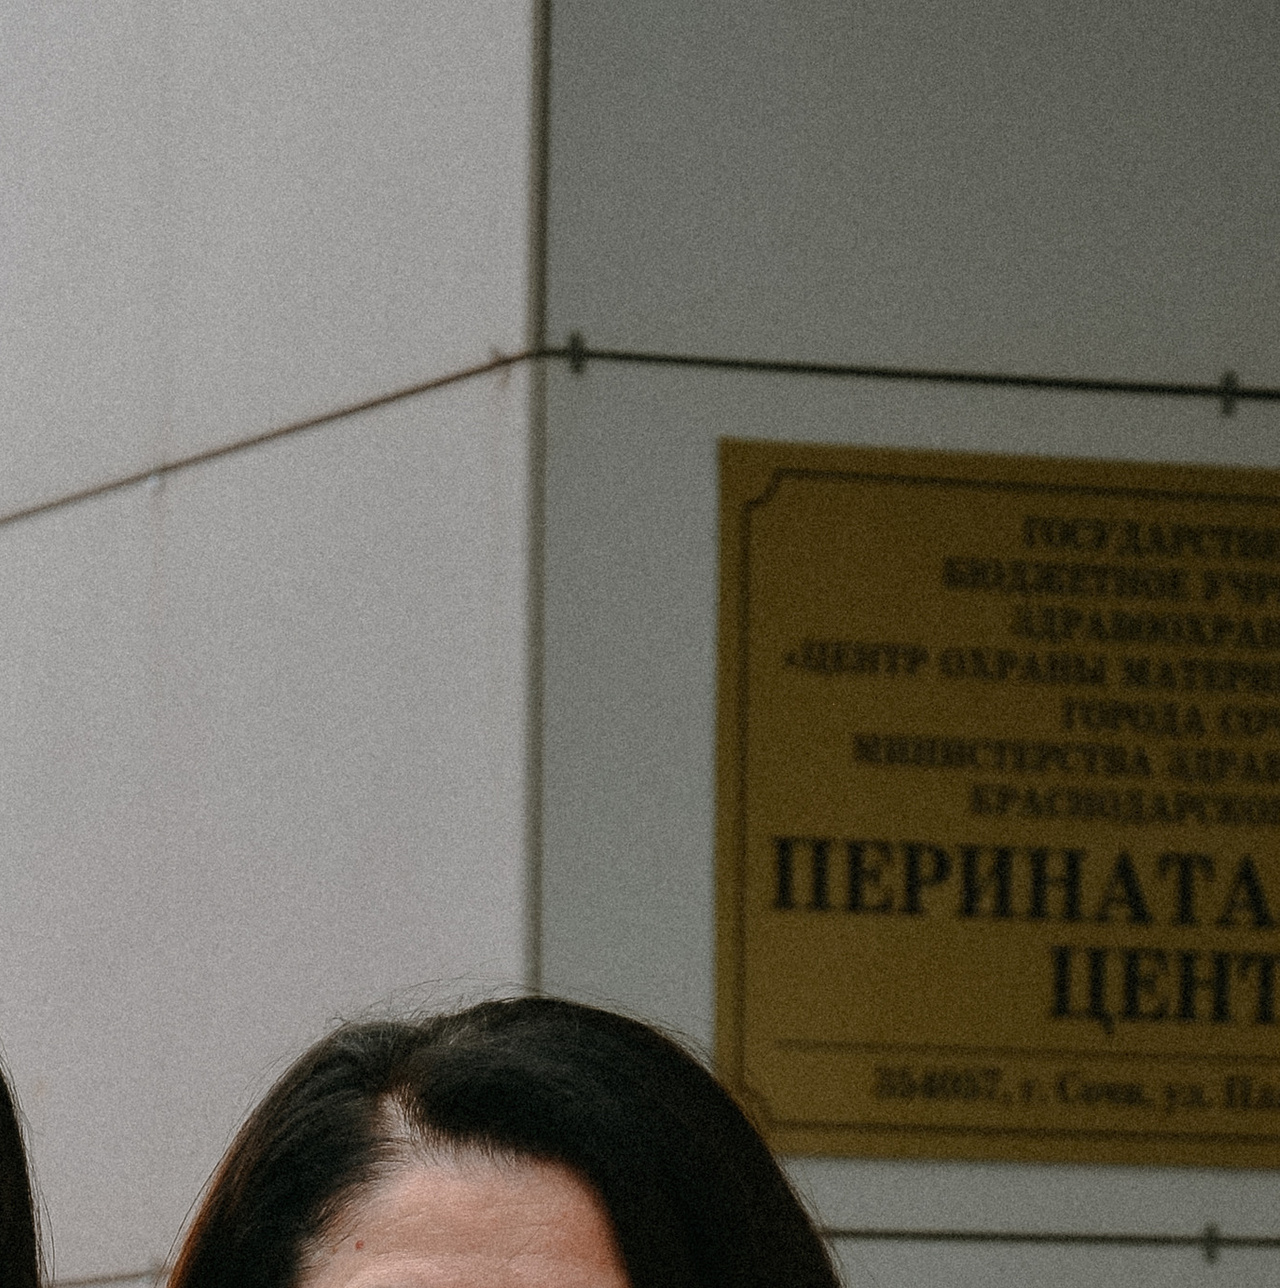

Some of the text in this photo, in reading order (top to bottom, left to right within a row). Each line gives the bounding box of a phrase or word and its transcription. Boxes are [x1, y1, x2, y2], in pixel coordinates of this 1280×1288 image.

[938, 647, 1108, 687] ОХРАНЫ
[1121, 657, 1280, 693] МАТЕРИ
[1062, 697, 1207, 738] ГОРОДА
[852, 732, 1153, 778] МИНИСТЕРСТВА
[771, 836, 1280, 928] ПЕРИНАТА
[1050, 945, 1280, 1035] ЦЕНТ
